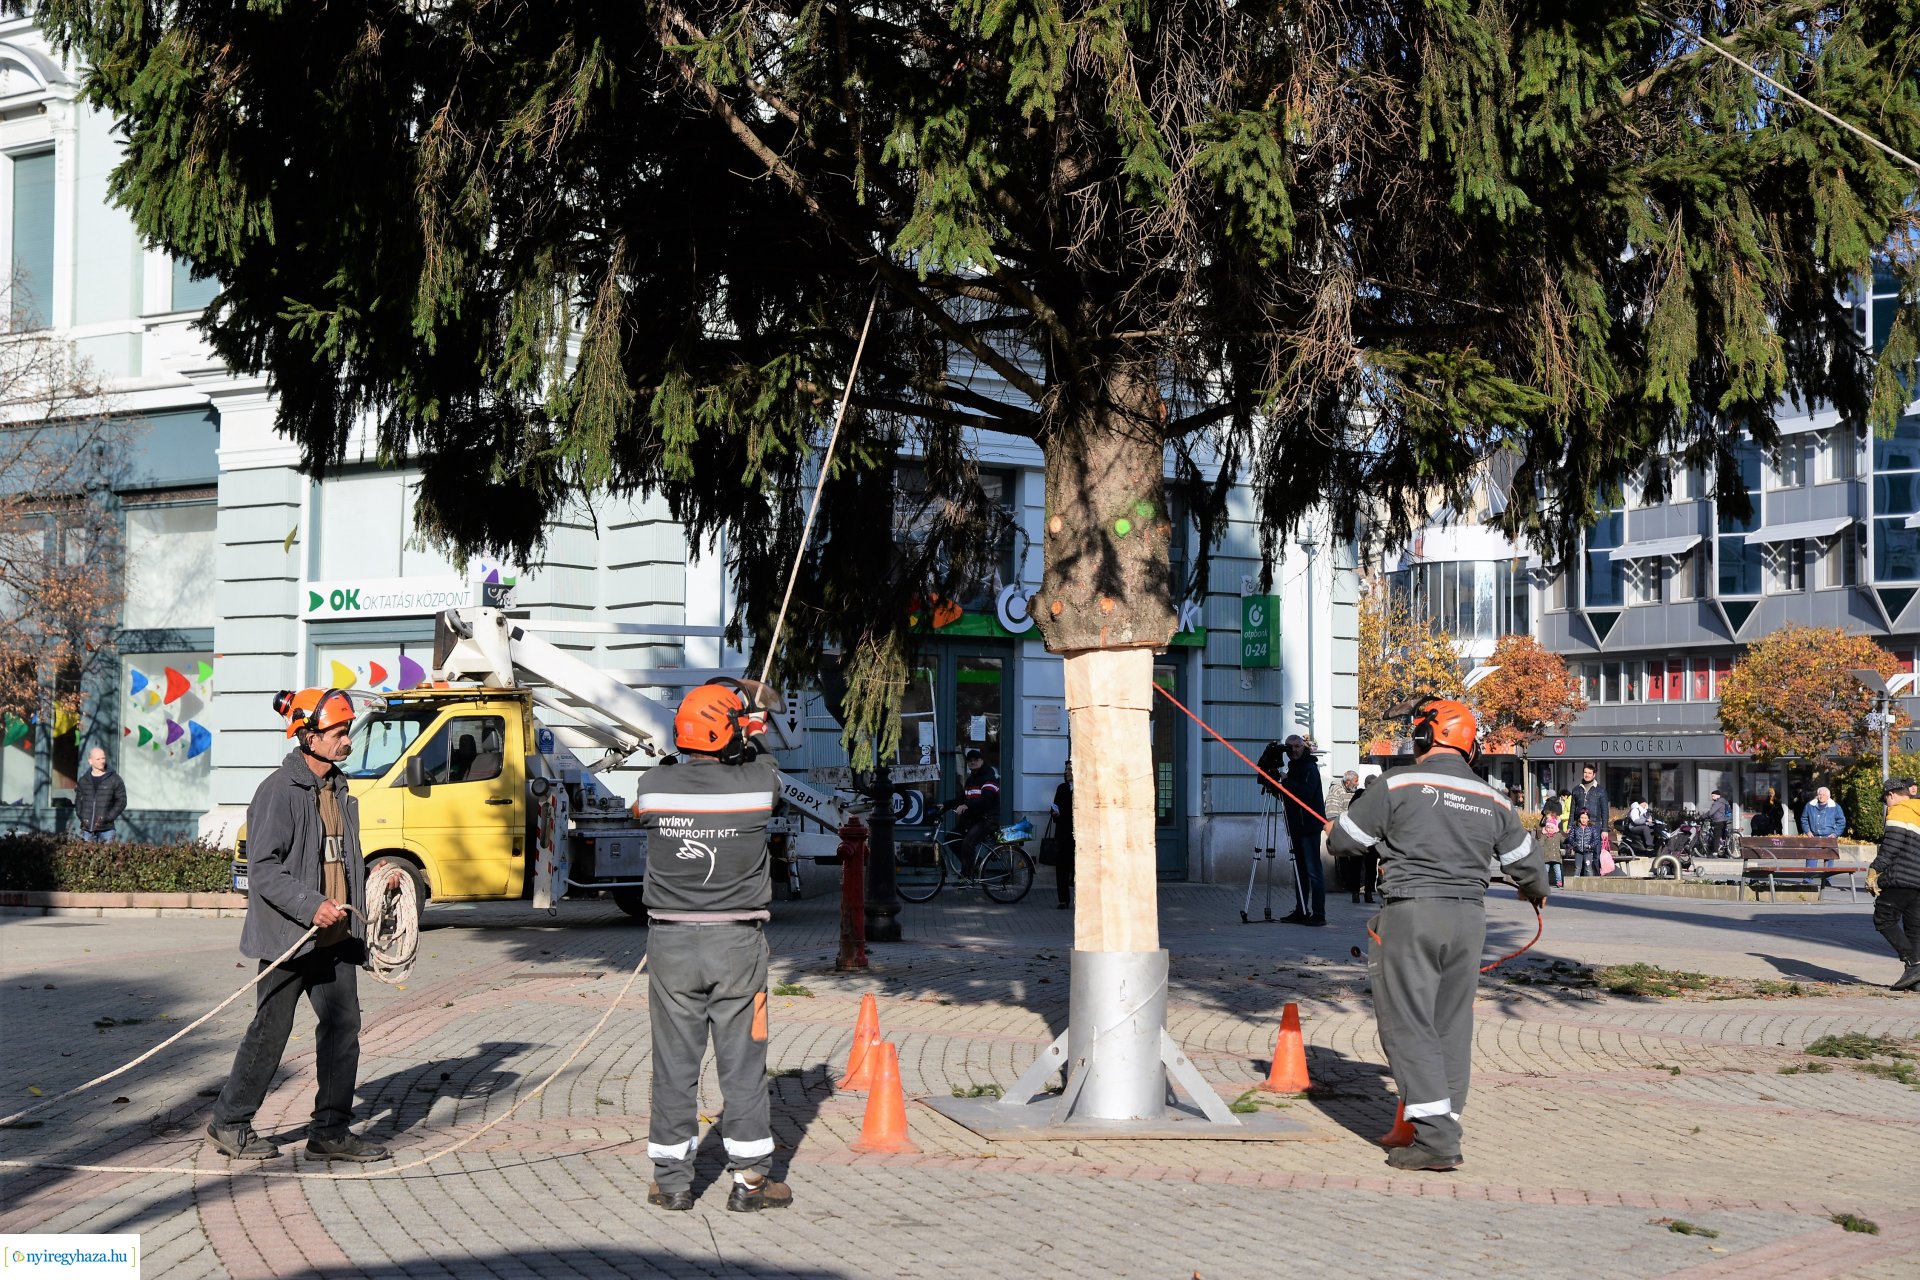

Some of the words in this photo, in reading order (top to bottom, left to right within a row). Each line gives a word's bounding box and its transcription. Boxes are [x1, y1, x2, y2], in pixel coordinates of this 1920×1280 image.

[330, 589, 360, 611] OK
[363, 591, 414, 610] OKTATÁSI
[417, 590, 470, 608] KÖZPONT
[1245, 643, 1267, 657] 0-24
[1601, 737, 1684, 752] DROGÉRIA
[1443, 800, 1479, 813] NONPROFIT
[658, 816, 695, 827] NYÍRVV
[659, 827, 716, 839] NONPROFIT
[717, 828, 739, 838] KFT.
